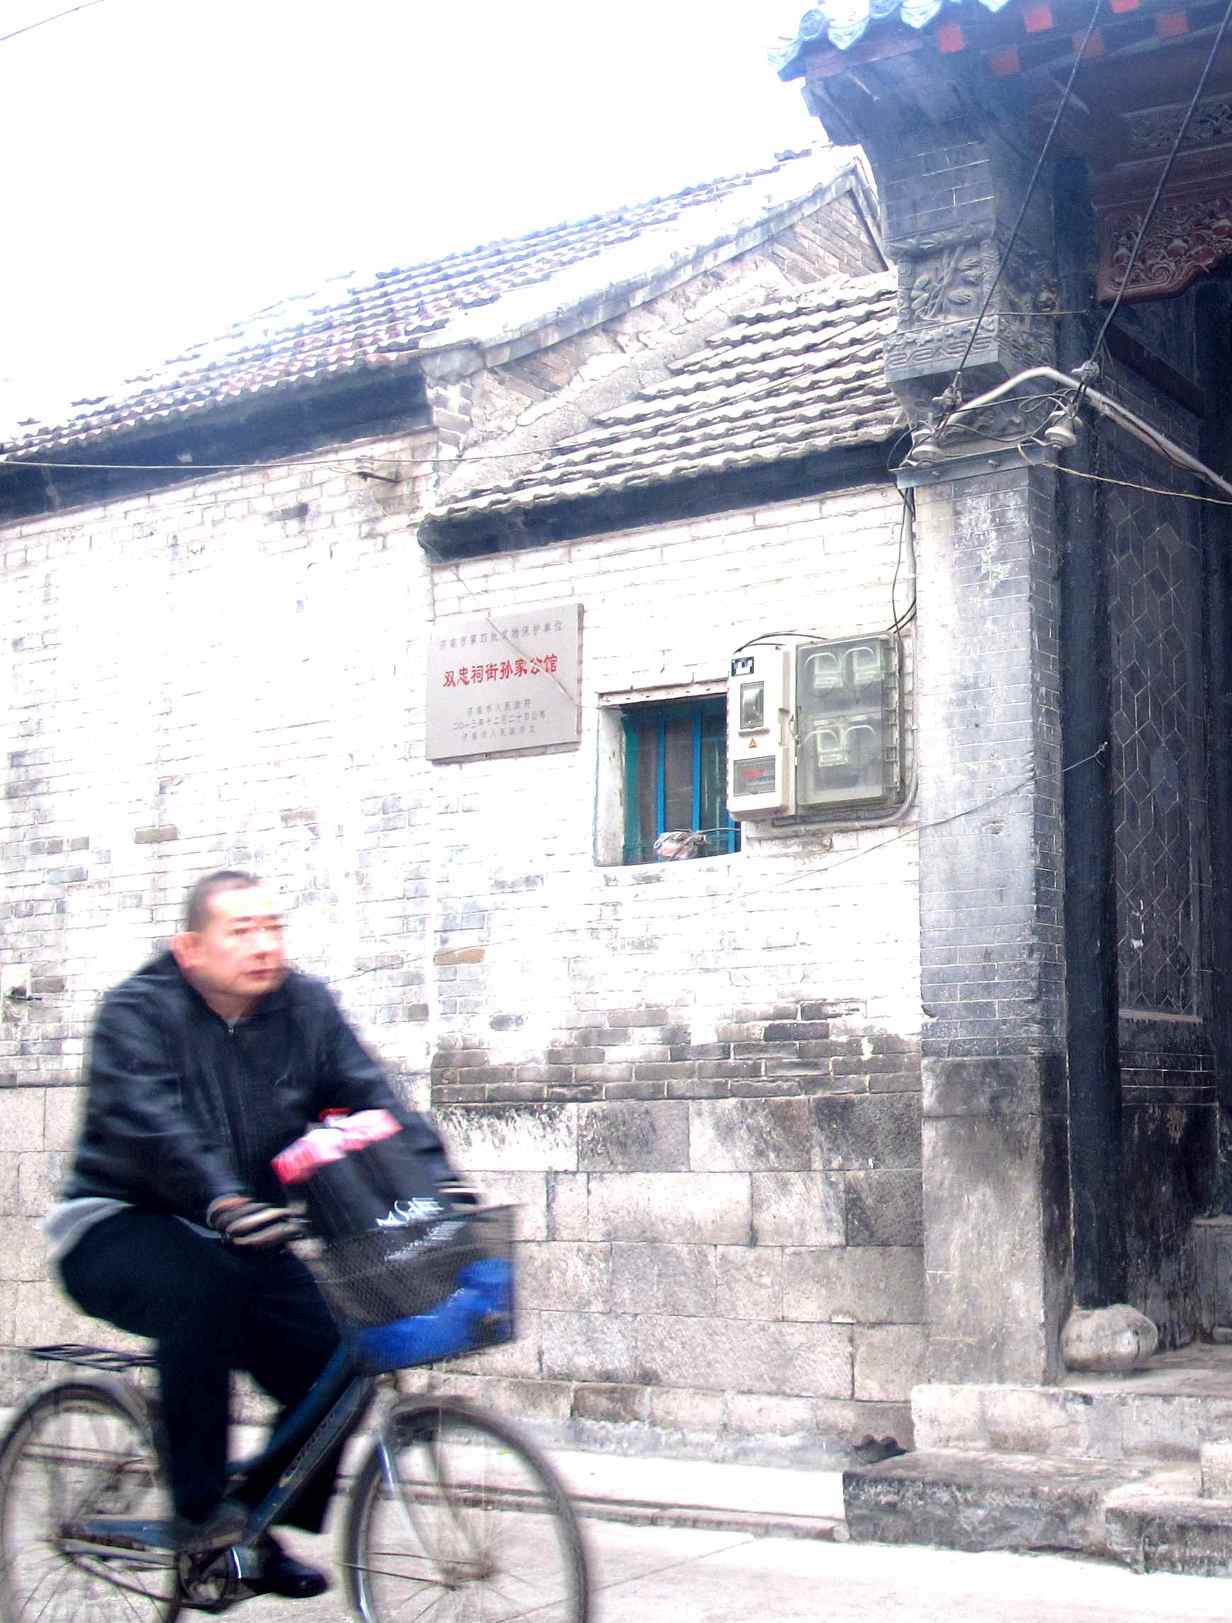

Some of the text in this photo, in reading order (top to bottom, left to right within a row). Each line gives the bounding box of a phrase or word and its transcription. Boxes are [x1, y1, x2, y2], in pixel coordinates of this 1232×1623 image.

[442, 653, 558, 688] 双忠祠街孙家公馆
